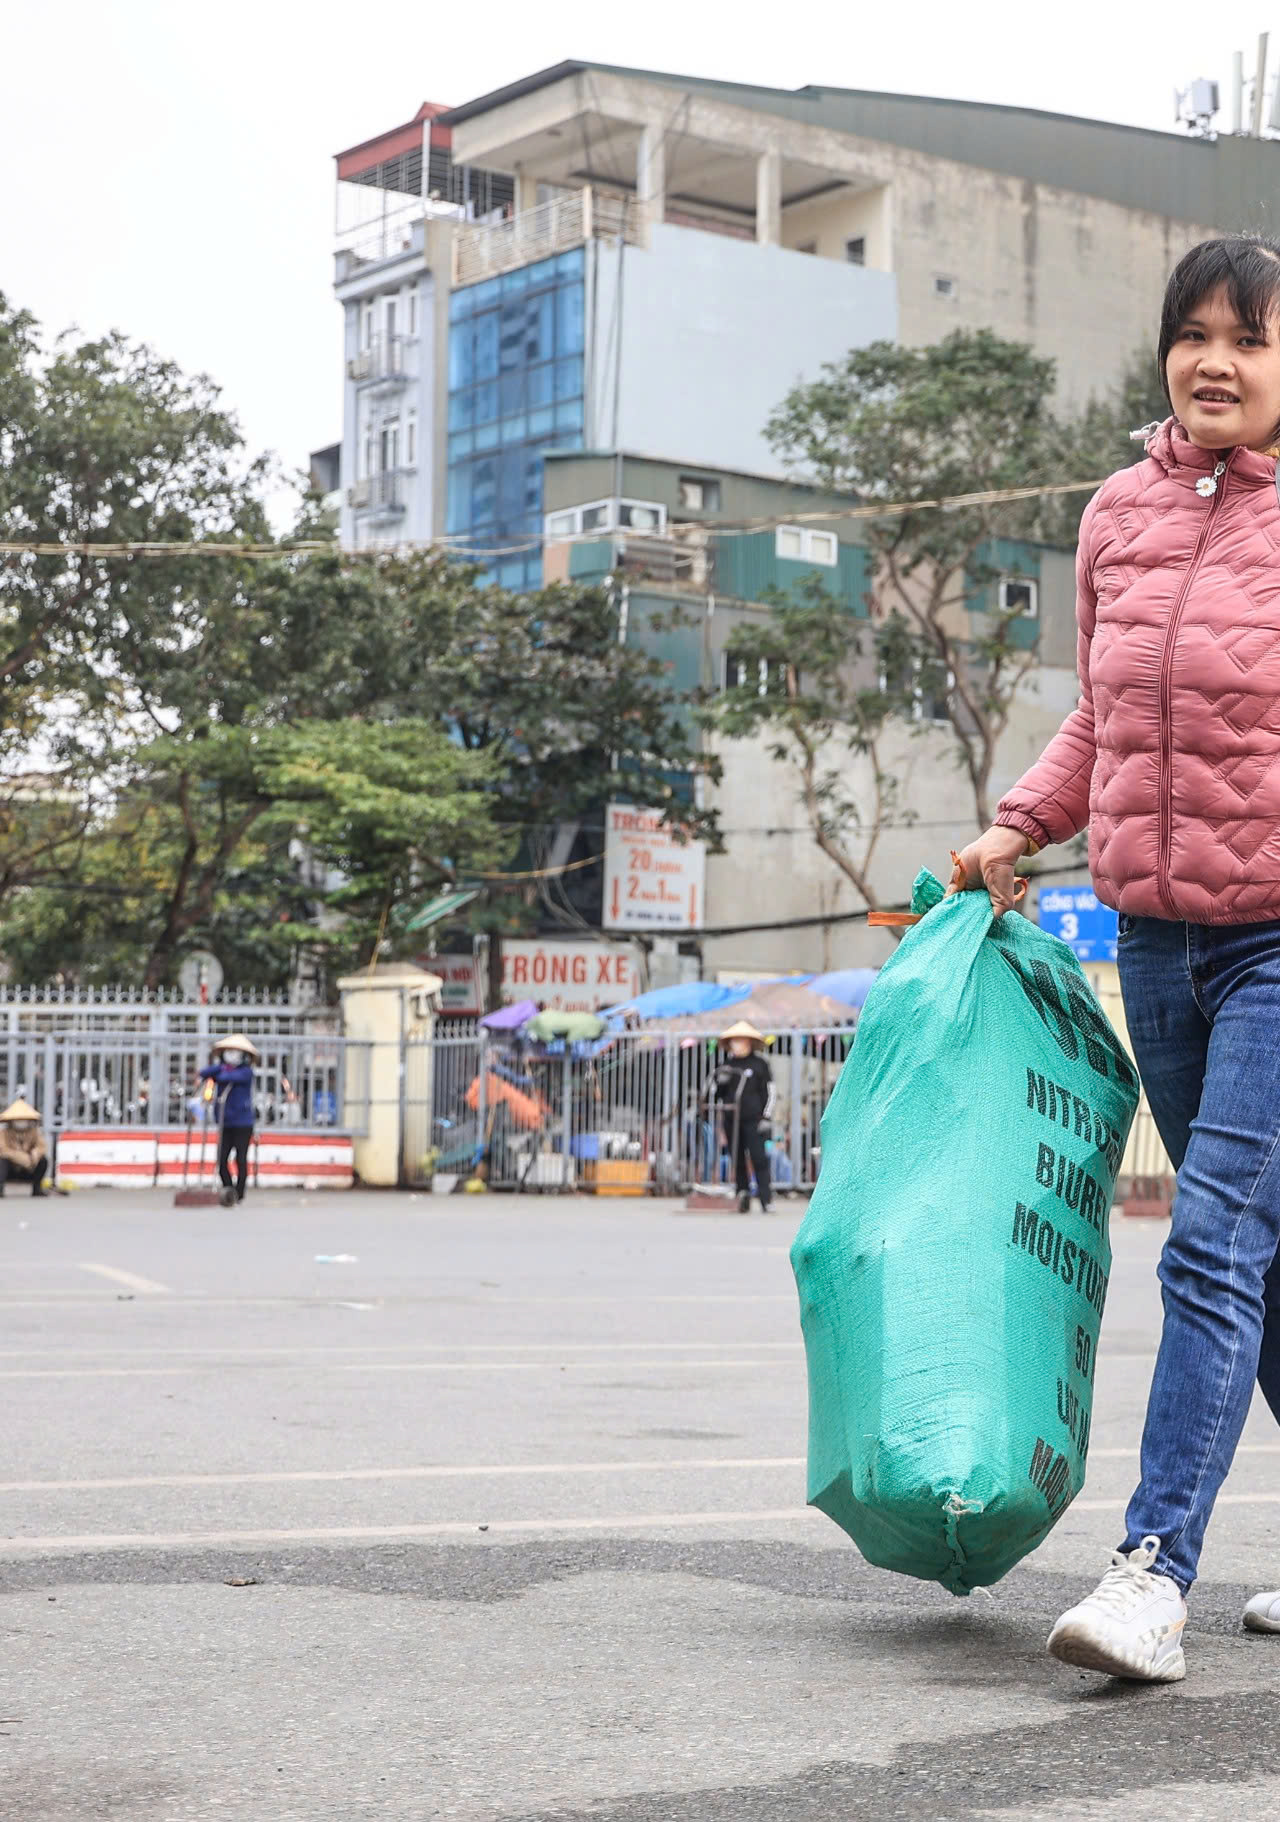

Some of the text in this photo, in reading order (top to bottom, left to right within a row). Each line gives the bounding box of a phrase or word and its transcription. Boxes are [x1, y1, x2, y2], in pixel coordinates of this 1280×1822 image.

[1060, 913, 1079, 940] 3
[596, 955, 629, 984] XE
[1076, 1325, 1090, 1378] 50
